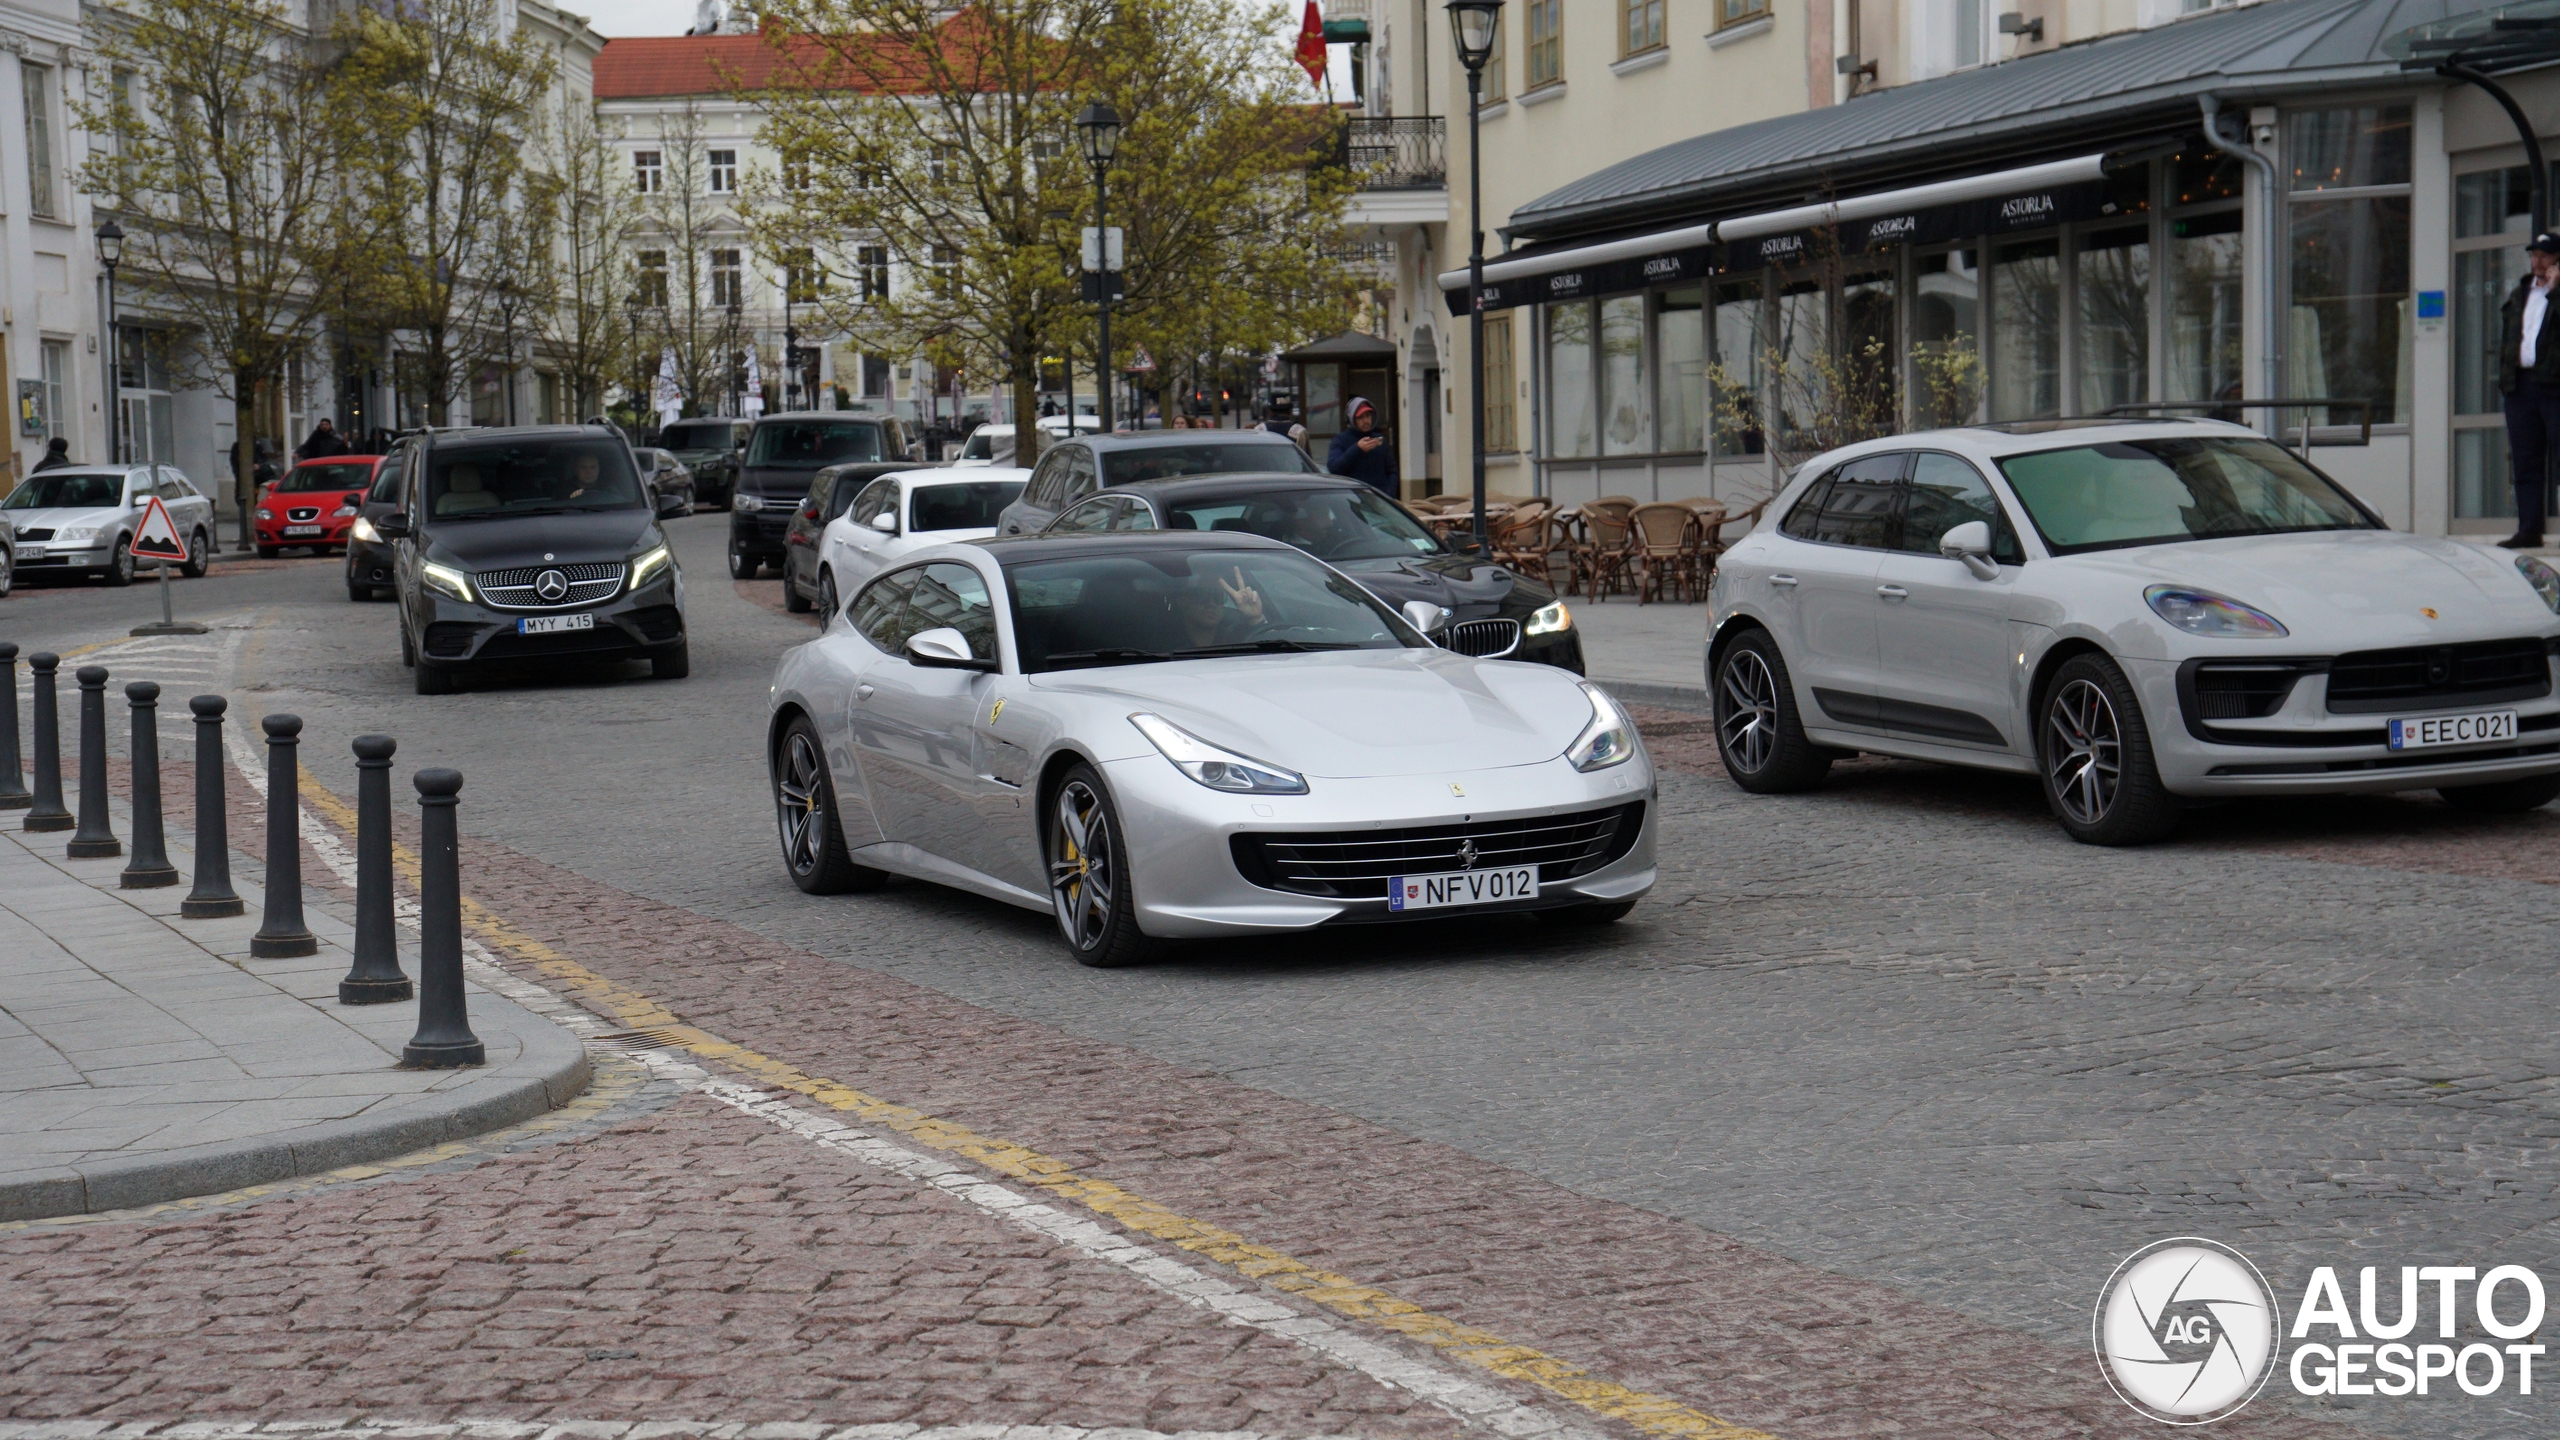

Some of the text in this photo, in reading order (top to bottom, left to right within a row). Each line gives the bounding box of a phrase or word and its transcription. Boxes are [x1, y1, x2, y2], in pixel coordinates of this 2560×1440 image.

[2001, 194, 2054, 217] ASTORIJA
[1869, 216, 1915, 237] ASTORIJA
[1760, 235, 1804, 255] ASTORIJA
[1643, 257, 1680, 275] ASTORIJA
[1550, 273, 1583, 290] ASTORIJA
[527, 615, 591, 632] MYY 415
[1392, 897, 1402, 905] LT
